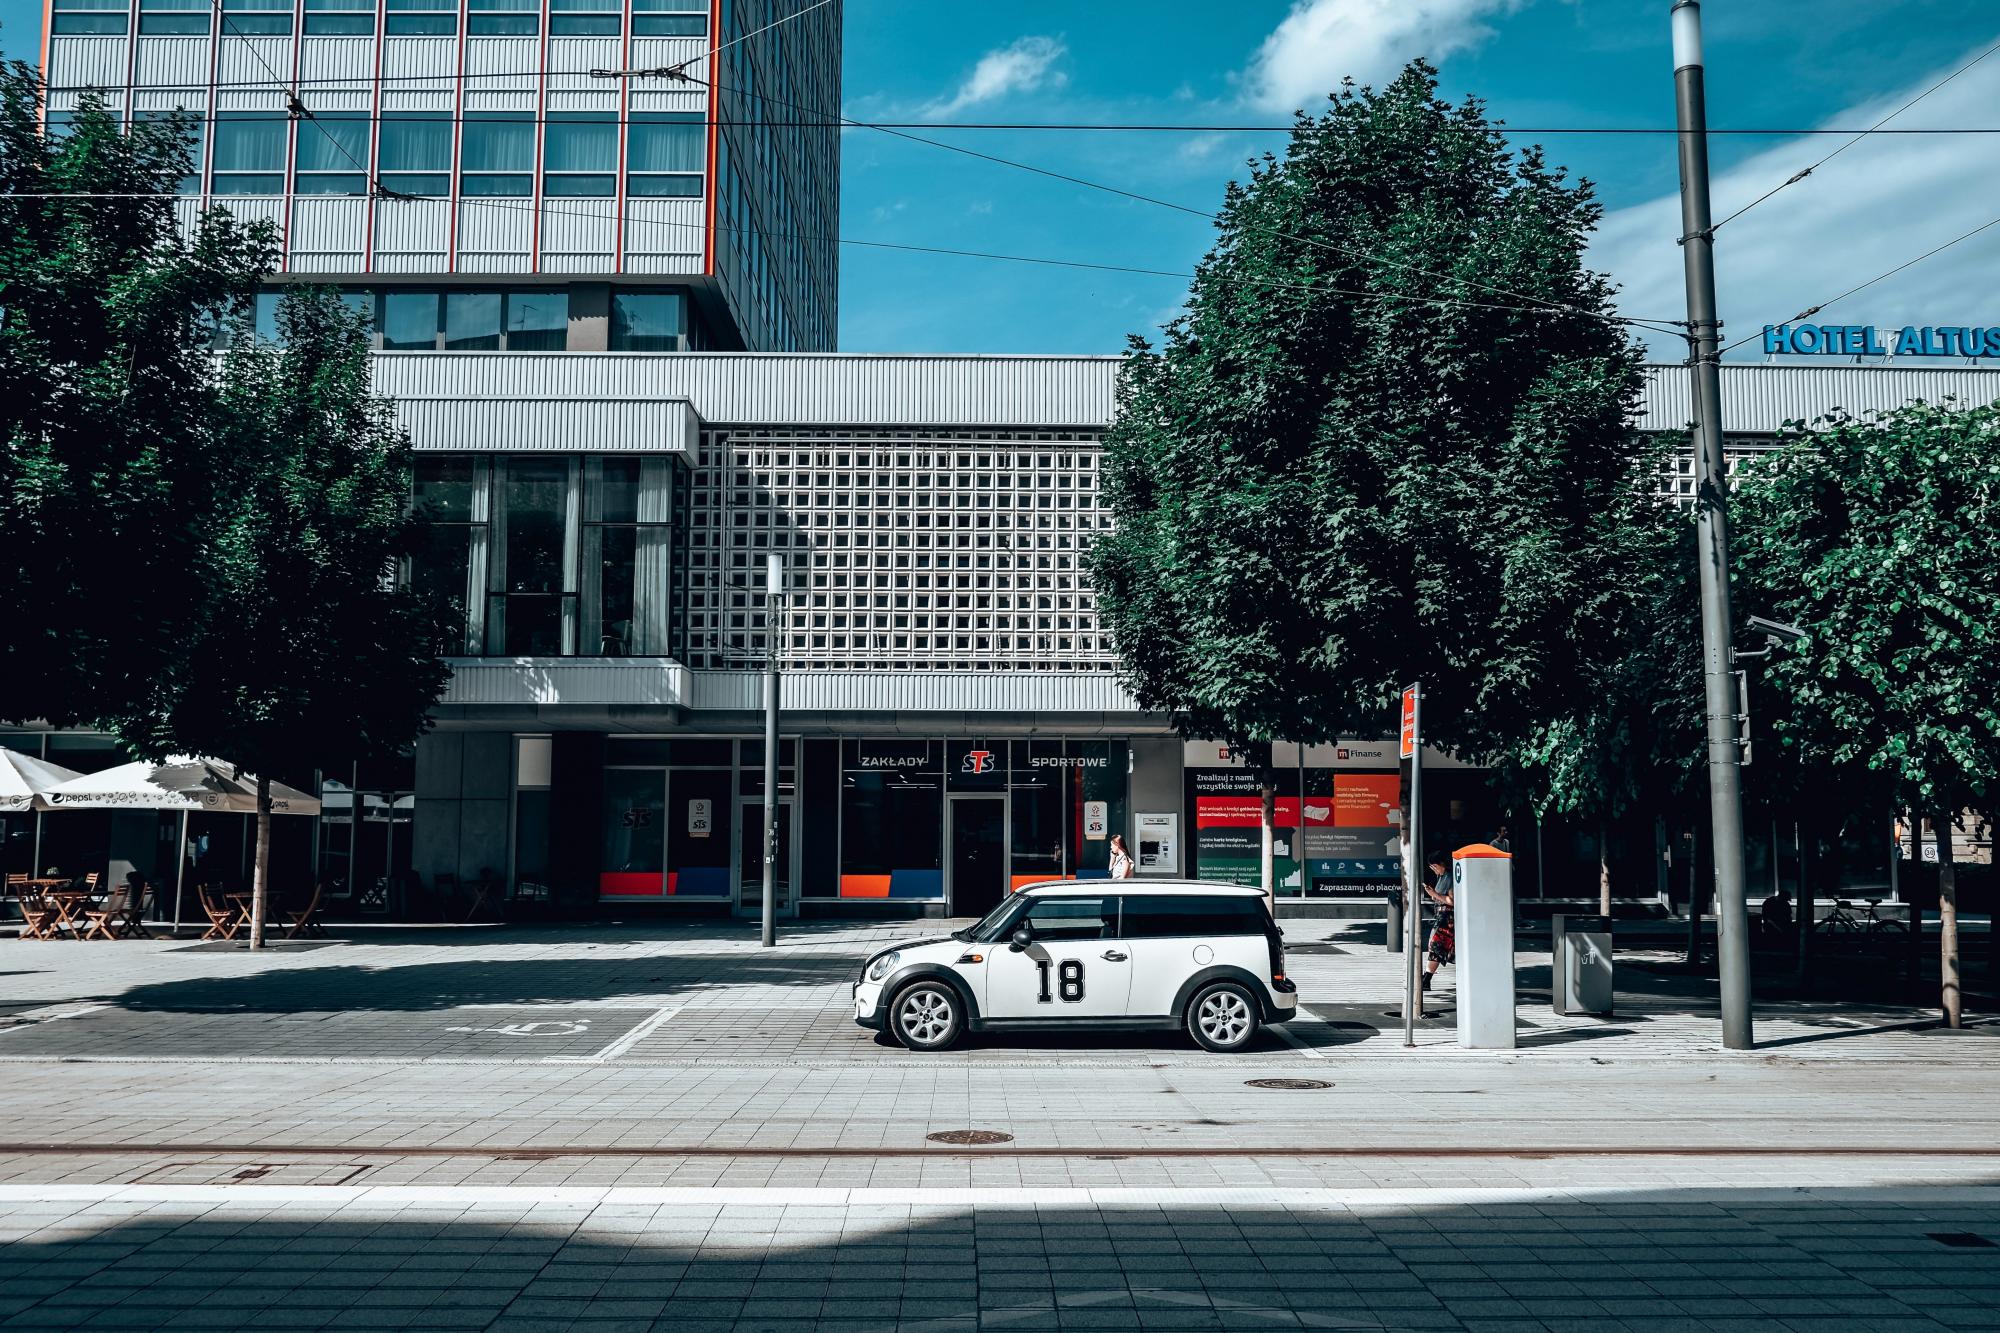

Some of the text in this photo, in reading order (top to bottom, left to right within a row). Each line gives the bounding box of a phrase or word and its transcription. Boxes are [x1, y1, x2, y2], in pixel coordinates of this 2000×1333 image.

[1763, 324, 2000, 357] HOTEL ALTUS
[1350, 750, 1382, 758] Finanse
[862, 756, 924, 767] ZAKŁADY
[962, 750, 994, 773] STS
[1032, 757, 1107, 768] SPORTOWE
[1196, 774, 1228, 782] Zrealizuj
[1235, 774, 1254, 782] nami
[1196, 782, 1233, 791] wszystkie
[1234, 783, 1255, 791] swoje
[66, 793, 92, 802] pepsi
[694, 820, 707, 830] STS
[1089, 822, 1103, 832] STS
[1320, 884, 1364, 892] Zapraszamy
[1036, 958, 1086, 1004] 18
